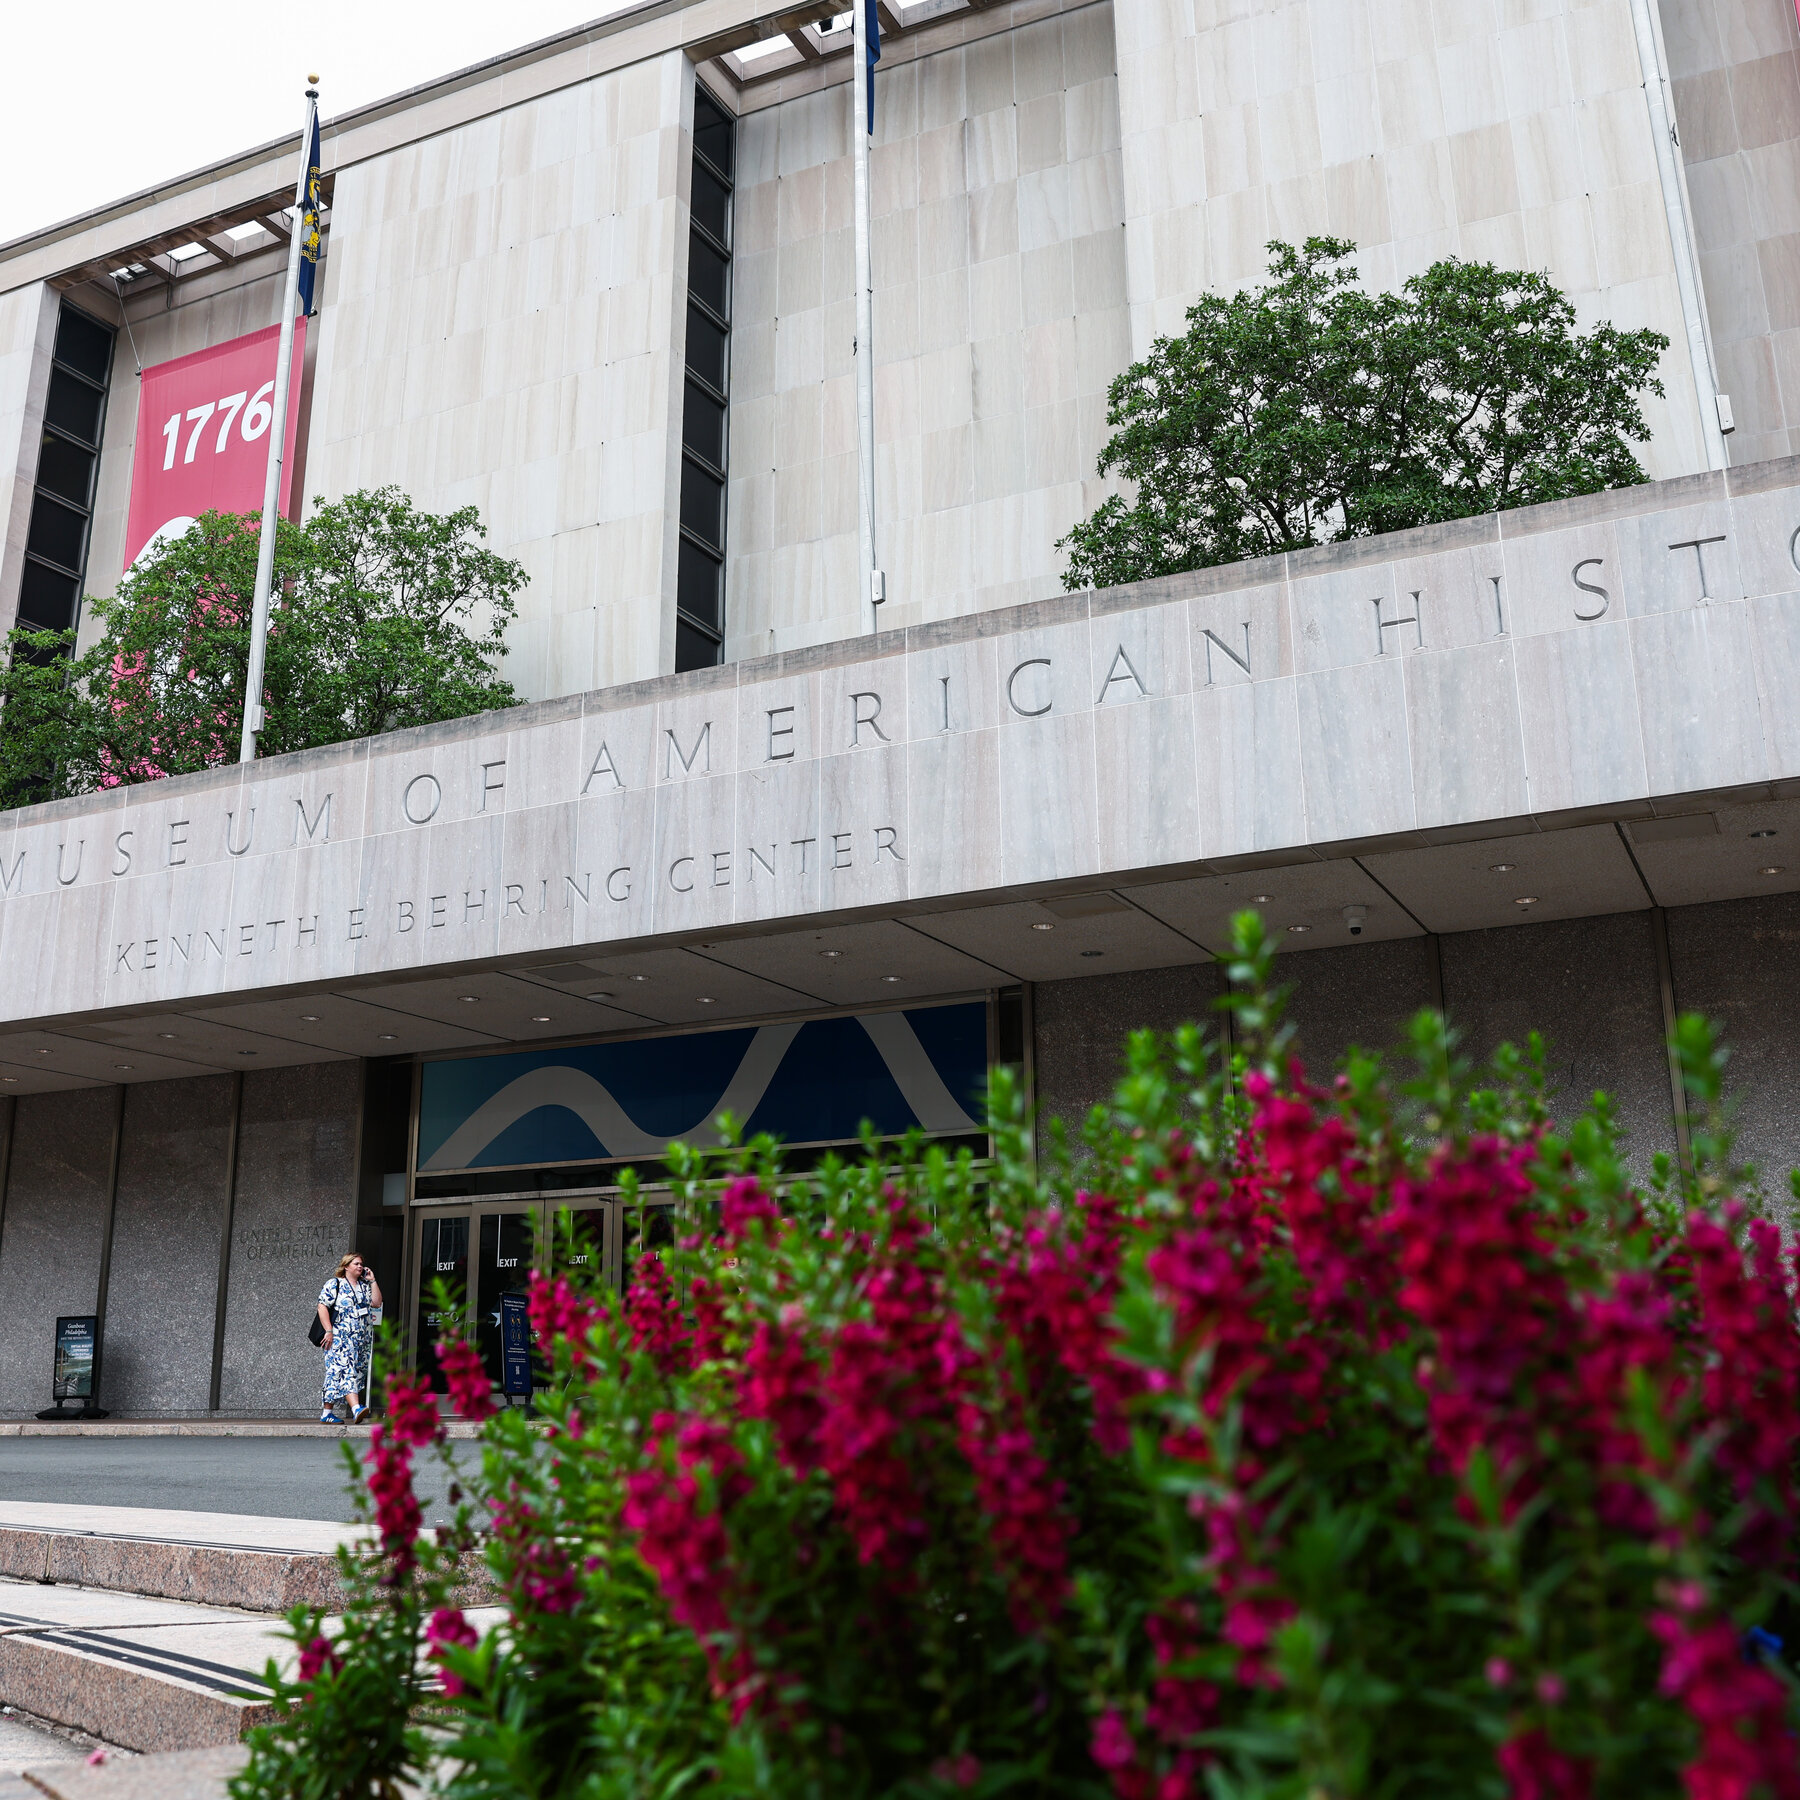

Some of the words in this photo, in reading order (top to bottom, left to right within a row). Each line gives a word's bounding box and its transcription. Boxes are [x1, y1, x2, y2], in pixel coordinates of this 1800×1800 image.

[162, 380, 275, 471] 1776
[402, 760, 506, 825] OF
[580, 621, 1253, 795] AMERICAN
[1369, 526, 1800, 657] HIST
[113, 914, 319, 975] KENNETH
[347, 908, 368, 941] E.
[394, 866, 632, 934] BEHRING
[668, 826, 905, 895] CENTER
[240, 1227, 292, 1244] UNITED
[298, 1225, 344, 1241] STATES
[247, 1245, 269, 1261] OF
[271, 1242, 334, 1261] AMERICA
[438, 1262, 455, 1271] EXIT
[499, 1258, 518, 1268] EXIT
